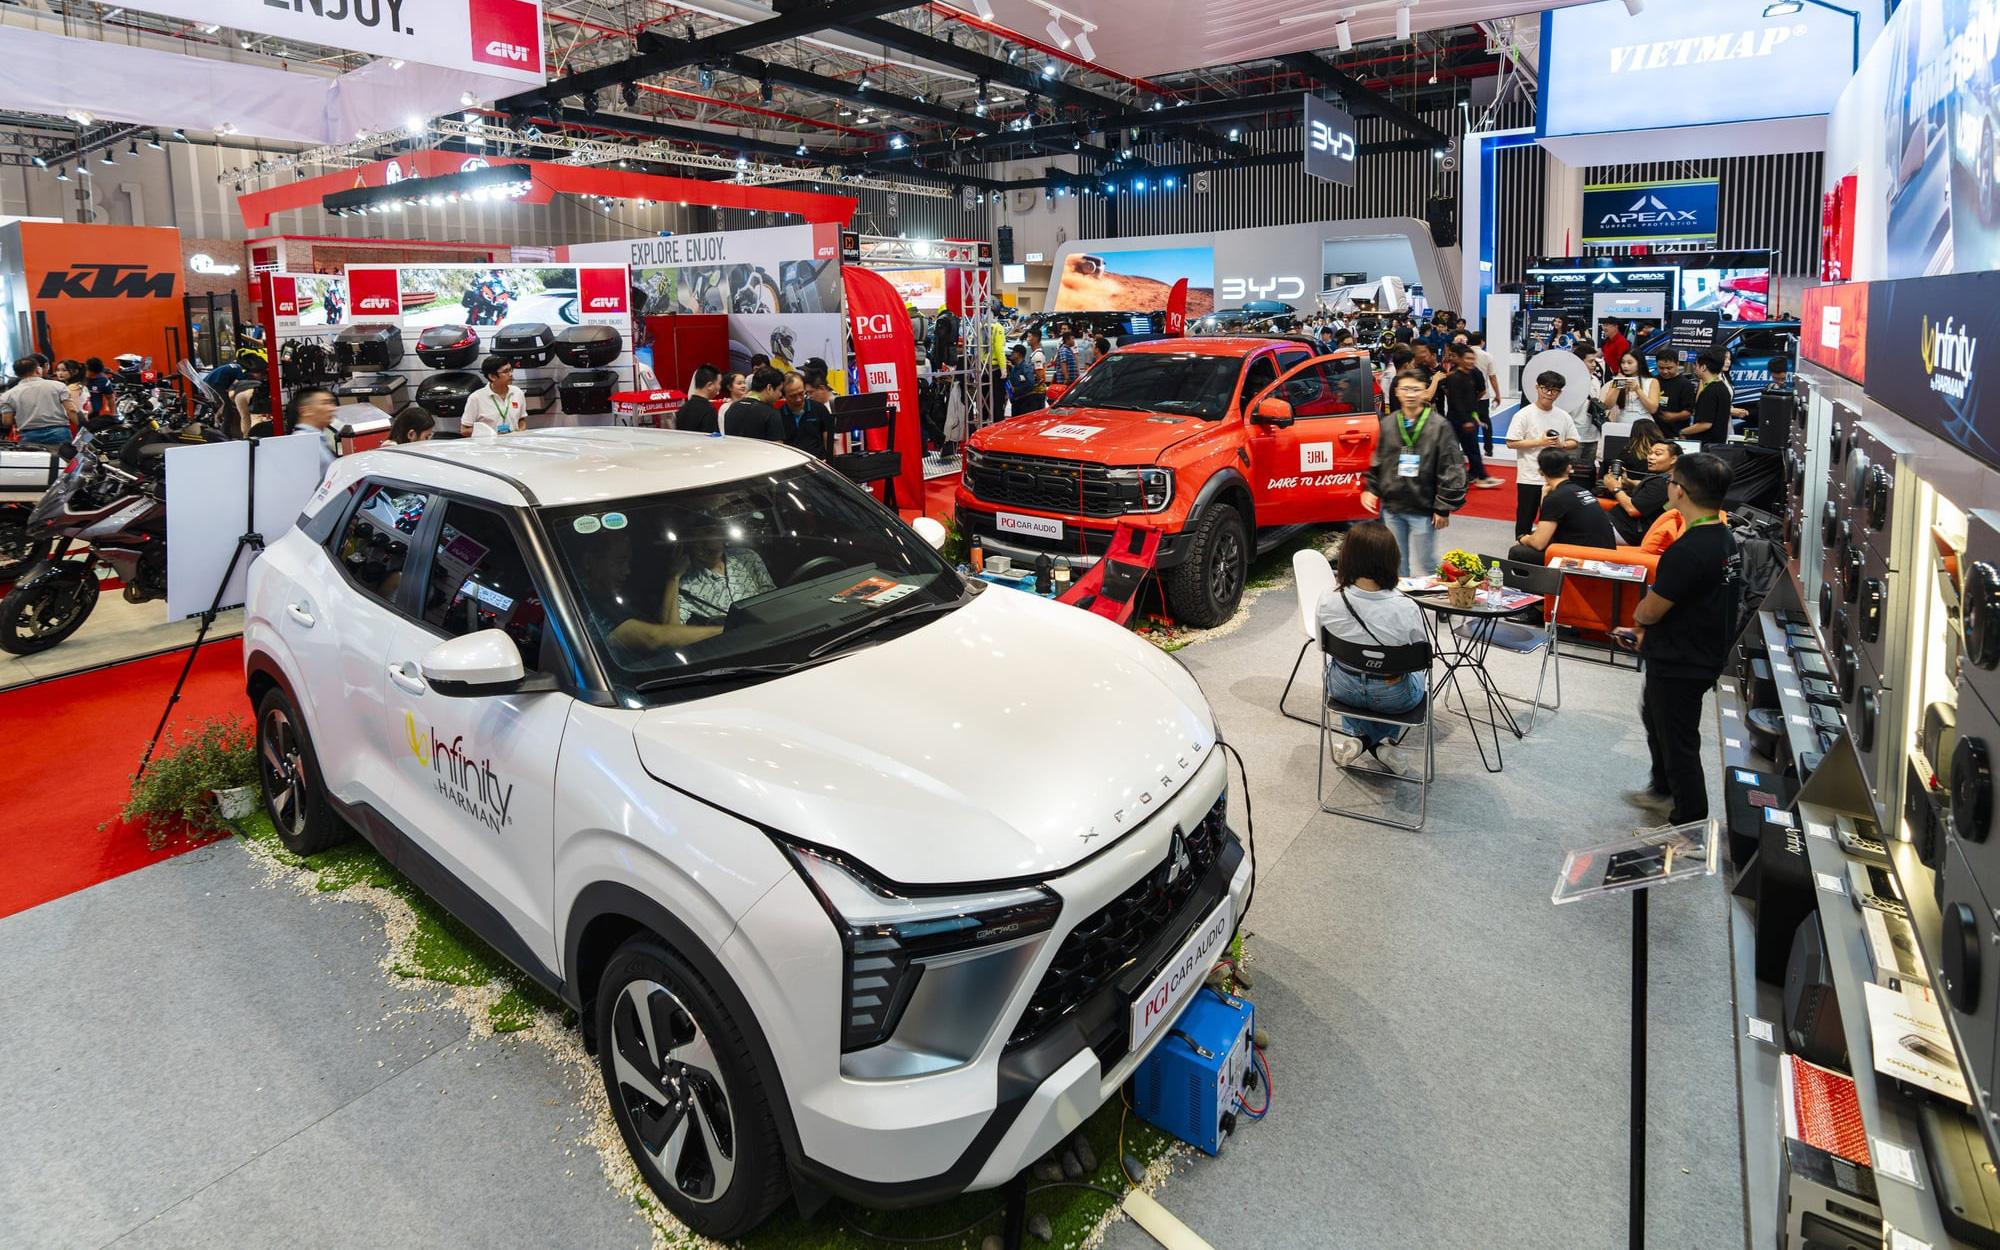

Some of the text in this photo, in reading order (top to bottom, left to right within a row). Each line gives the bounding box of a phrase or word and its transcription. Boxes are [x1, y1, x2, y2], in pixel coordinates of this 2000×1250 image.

[485, 41, 528, 62] GIVI
[1310, 120, 1355, 161] BYD
[1600, 210, 1697, 224] APEAX
[631, 237, 726, 266] EXPLORE. ENJOY.
[818, 247, 834, 256] GIVI
[37, 264, 175, 298] KTM
[1222, 277, 1305, 300] BYD
[279, 302, 294, 312] GIVI
[360, 298, 390, 309] GIVI
[590, 297, 619, 308] GIVI
[856, 314, 893, 335] PGI
[1695, 327, 1713, 337] M2
[1934, 316, 1977, 388] Infinity
[869, 370, 892, 385] JBL
[1935, 373, 1965, 399] HARMAN
[649, 392, 671, 401] GIVI
[888, 392, 900, 401] TO
[1307, 451, 1328, 464] JBL
[1267, 477, 1299, 490] DARE
[1300, 477, 1313, 486] TO
[1001, 517, 1057, 534] PGI CAR AUDIO
[431, 726, 512, 827] Infinity
[438, 779, 500, 835] HARMAN
[1145, 917, 1225, 1028] PGI CAR AUDIO
